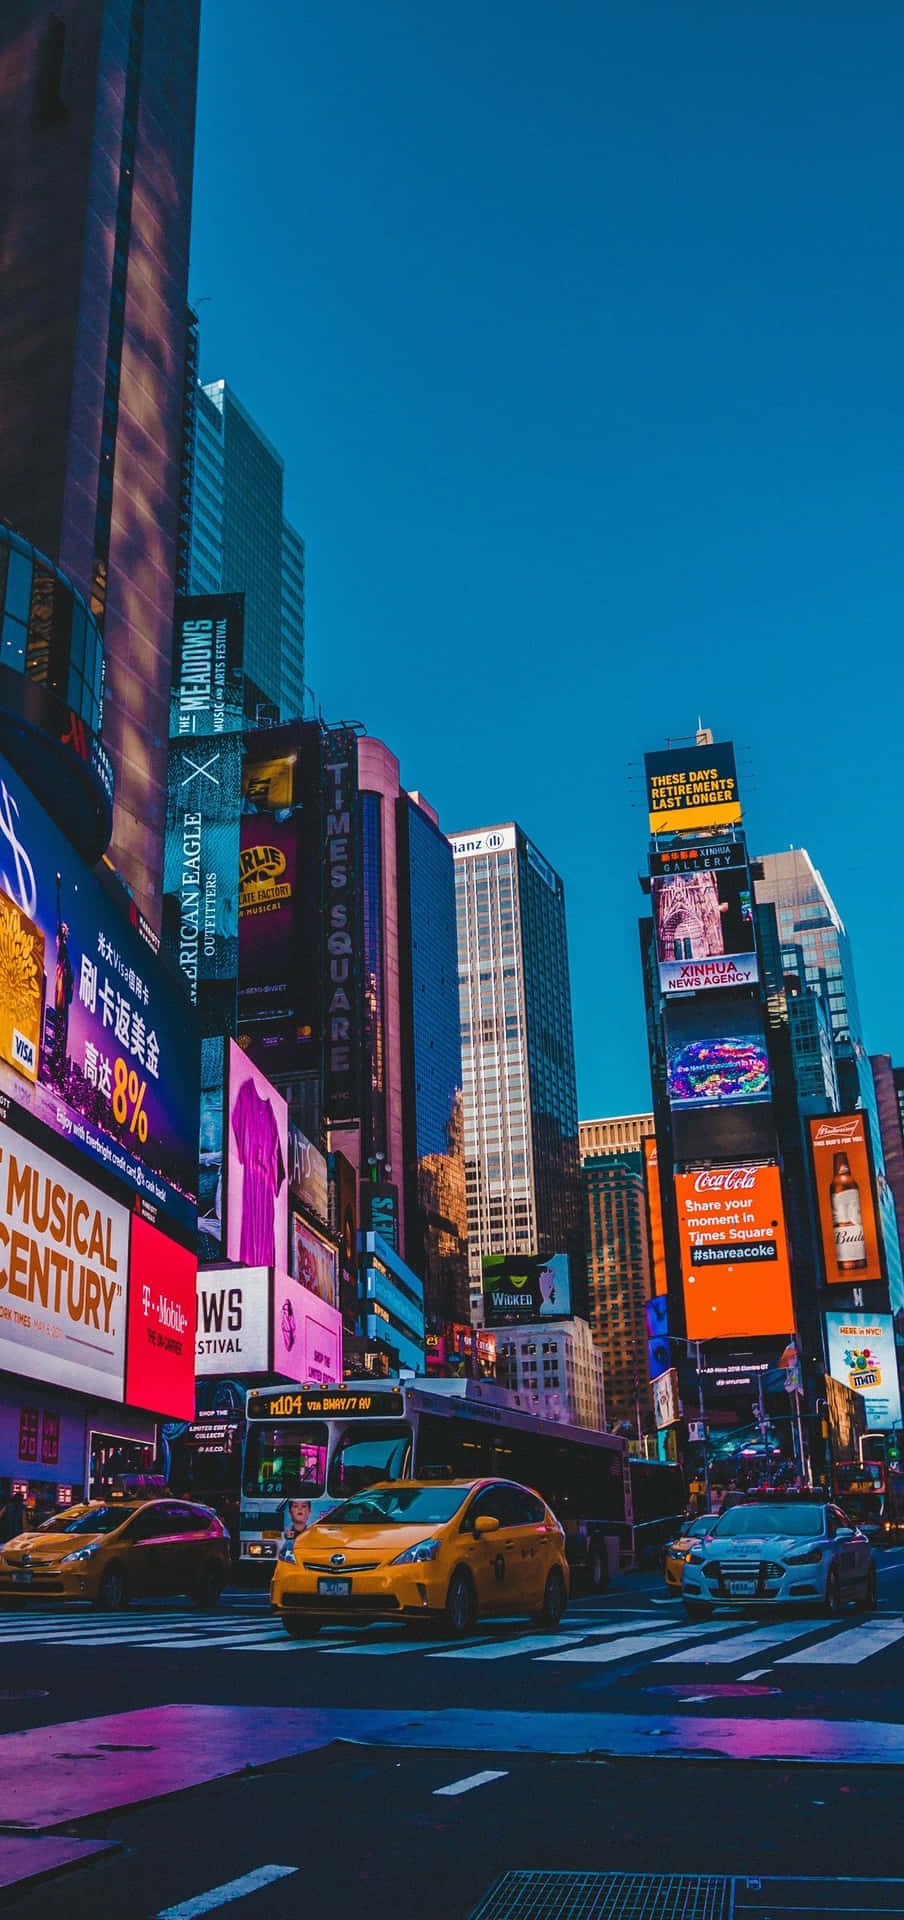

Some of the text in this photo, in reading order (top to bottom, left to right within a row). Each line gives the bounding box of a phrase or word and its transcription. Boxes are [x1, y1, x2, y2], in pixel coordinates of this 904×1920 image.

[216, 618, 227, 660] FESTIVAL
[180, 619, 213, 711] MEADOWS
[214, 662, 225, 686] ARTS
[179, 715, 190, 734] THE
[213, 703, 225, 732] MUSIC
[651, 769, 718, 787] THESE DAYS
[651, 778, 735, 799] RETIREMENTS
[652, 790, 733, 810] LAST LONGER
[325, 762, 350, 888] TIMES
[183, 812, 202, 886] EAGLE
[663, 856, 732, 872] GALLERY
[258, 887, 289, 901] FACTORY
[204, 872, 217, 957] OUTFITTERS
[680, 961, 738, 979] XINHUA
[327, 903, 352, 1071] SQUARE
[668, 972, 751, 990] NEWS AGENCY
[79, 953, 160, 1079] 刷卡返美金
[16, 1036, 32, 1066] VISA
[6, 1154, 118, 1273] MUSICAL
[685, 1199, 753, 1212] Share your
[687, 1212, 755, 1227] moment in
[688, 1228, 774, 1243] Times Square
[693, 1244, 775, 1262] #shareacoke
[270, 1395, 302, 1415] M104
[358, 1397, 371, 1410] AV
